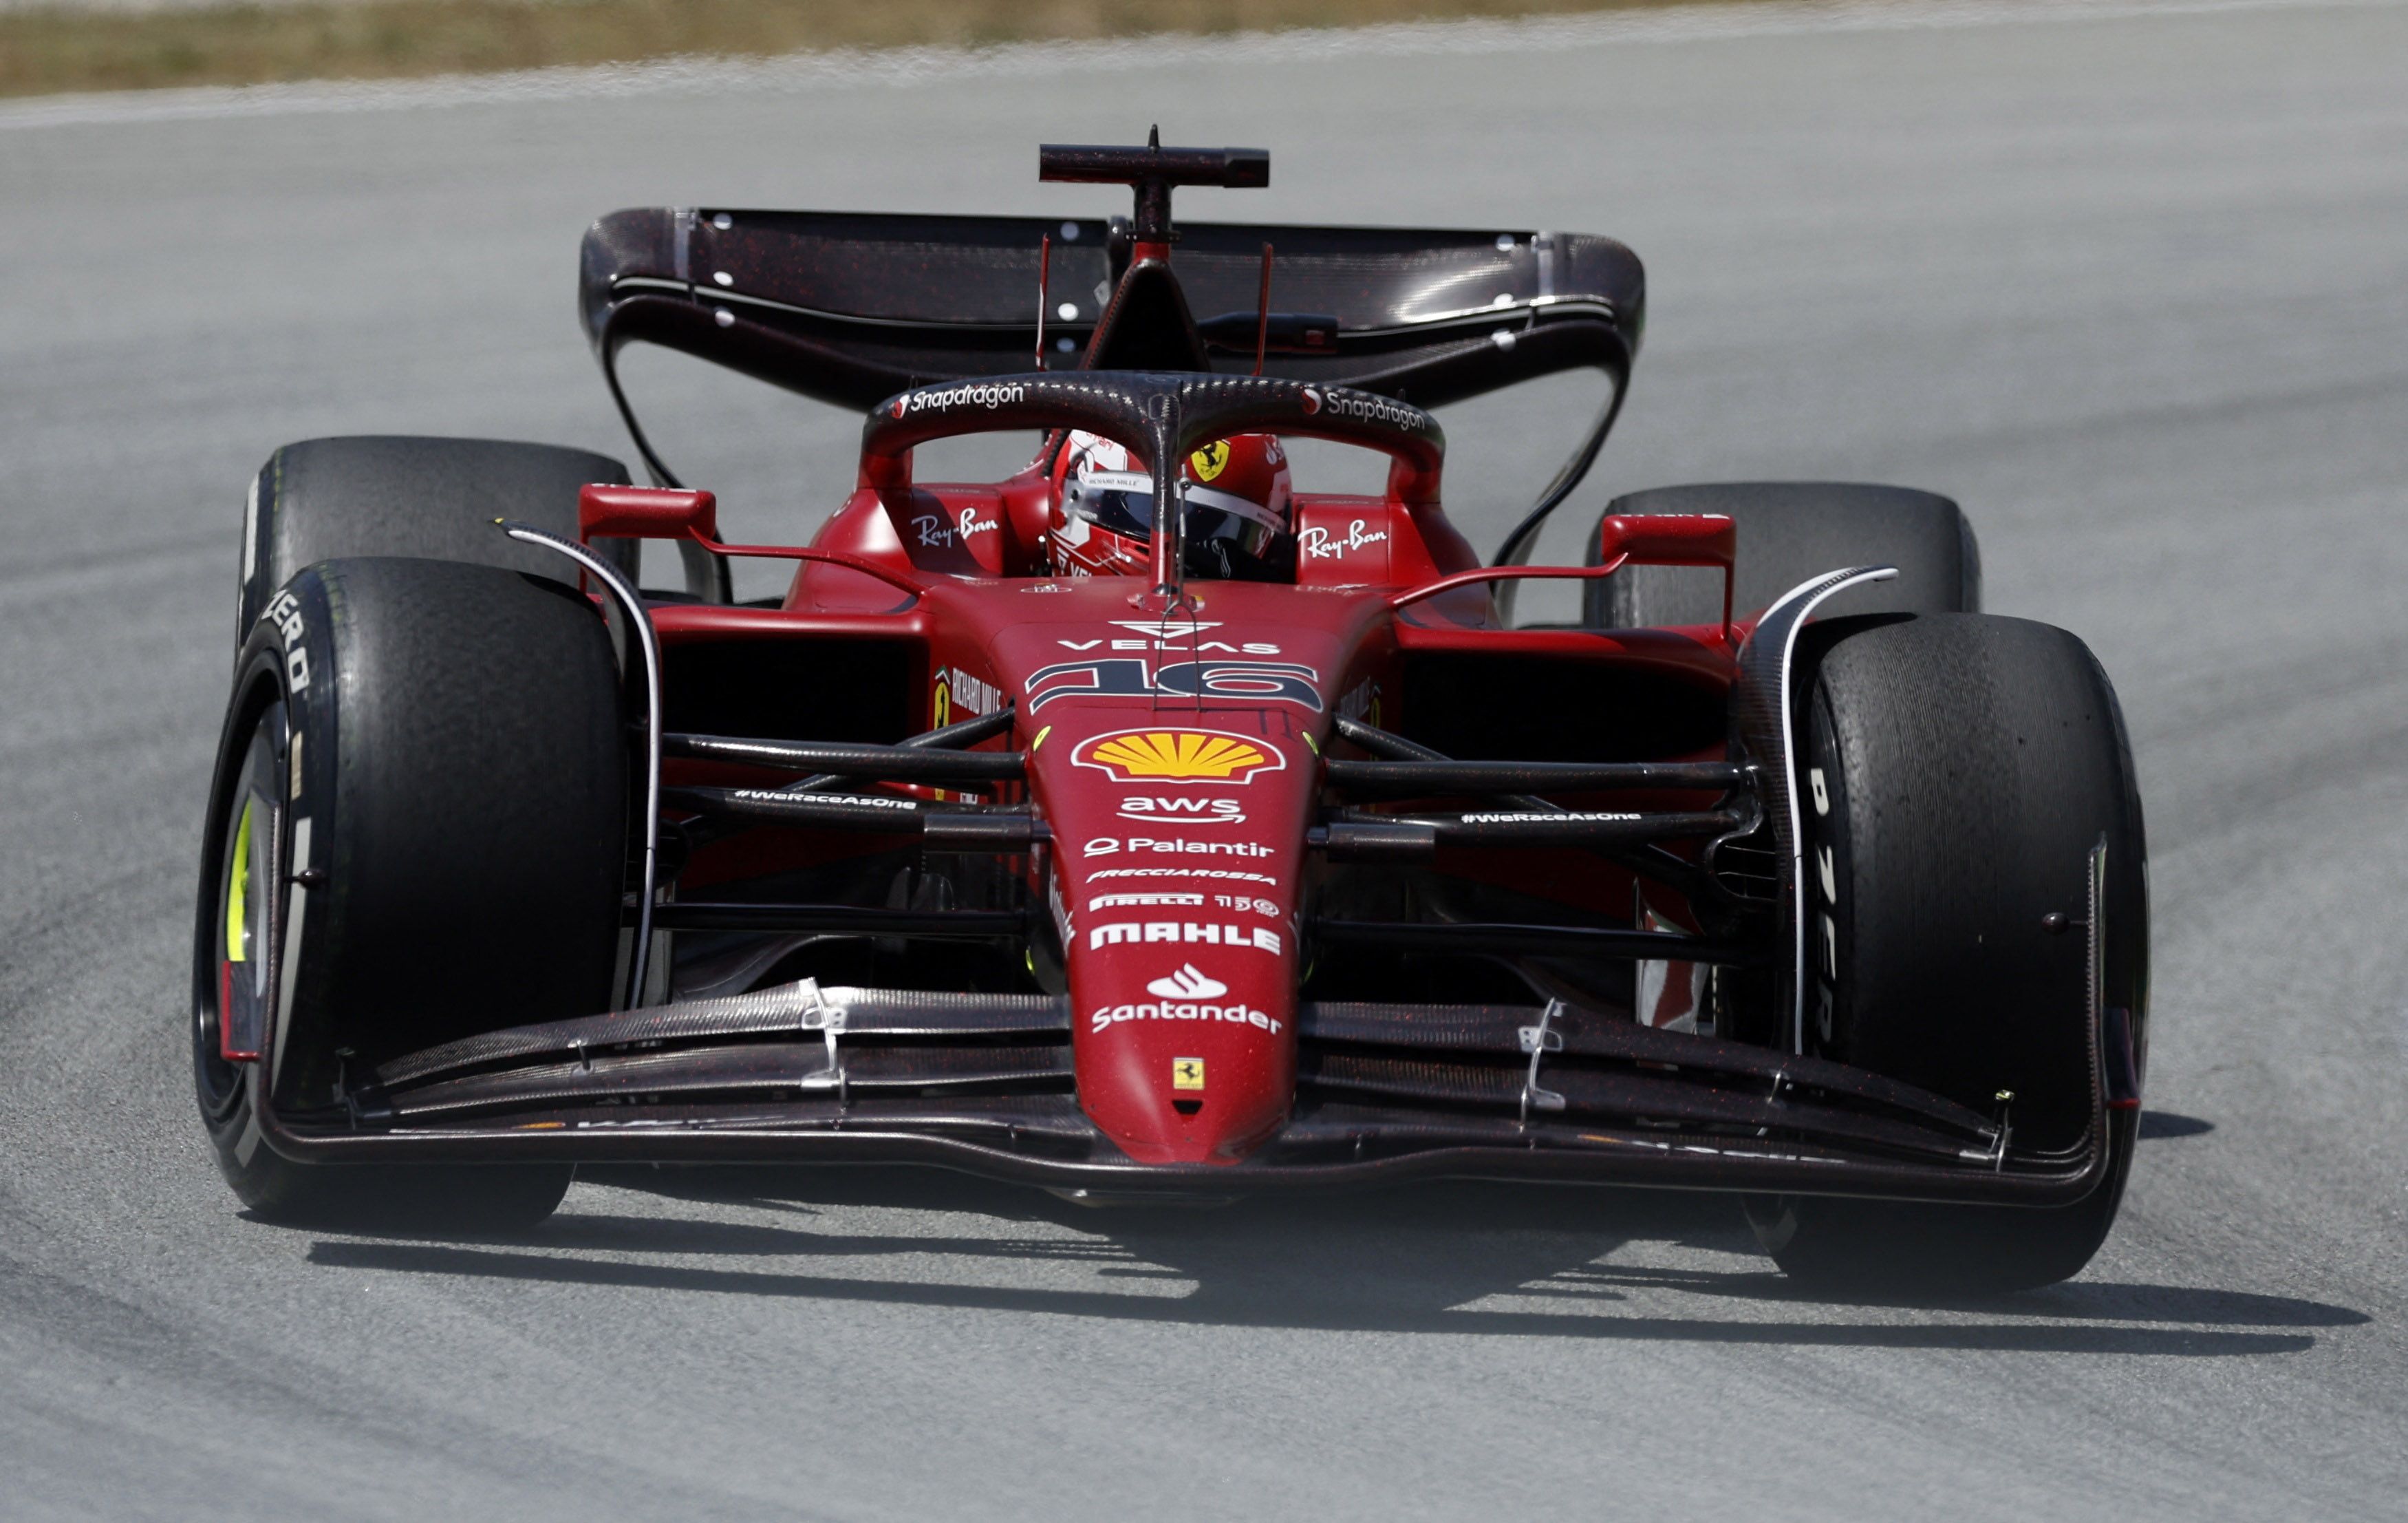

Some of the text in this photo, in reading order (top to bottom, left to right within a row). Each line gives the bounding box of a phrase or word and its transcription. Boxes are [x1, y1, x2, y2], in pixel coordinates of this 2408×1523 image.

[910, 384, 1024, 412] Snapdragon
[1326, 392, 1426, 431] Snapdragon
[911, 507, 998, 549] Ray-Ban
[1297, 519, 1388, 559] Ray-Ban
[1057, 639, 1281, 655] VELAS
[952, 667, 1002, 716] RICHARD MILLE
[1024, 659, 1324, 716] 16
[734, 789, 917, 810] #WeRaceAsOne
[1121, 796, 1241, 814] aws
[1461, 813, 1642, 823] #WeRaceAsOne
[1128, 838, 1275, 858] Palantir
[1085, 869, 1277, 886] FRECCIAROSSA
[1089, 893, 1205, 913] PIRELLI
[1090, 922, 1281, 957] MAHLE
[1092, 1000, 1283, 1035] Santander
